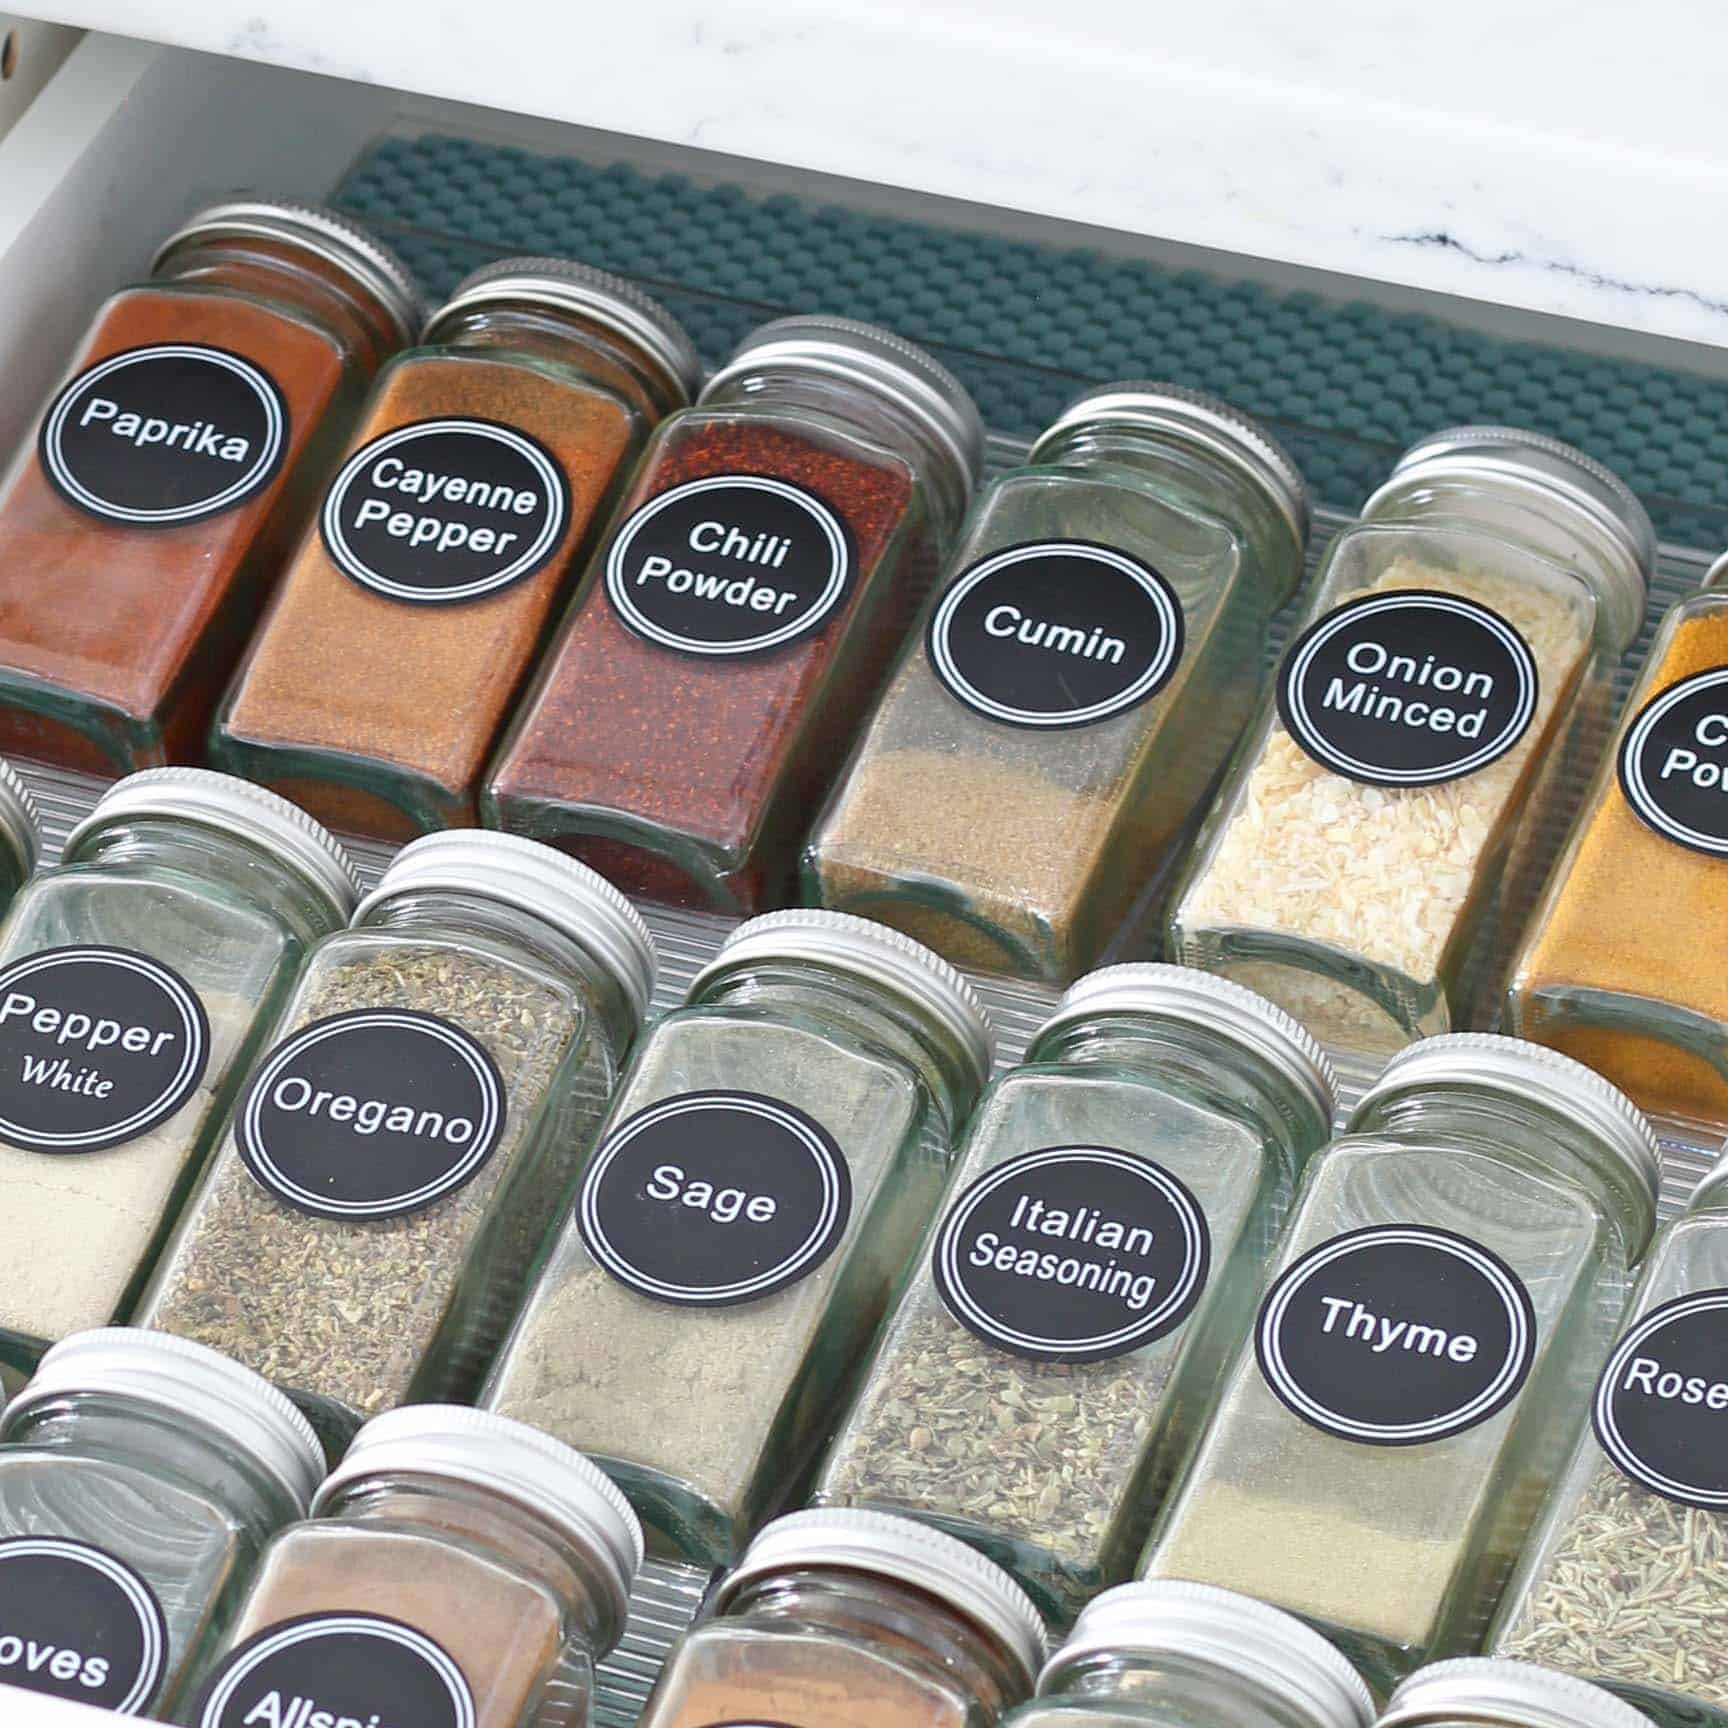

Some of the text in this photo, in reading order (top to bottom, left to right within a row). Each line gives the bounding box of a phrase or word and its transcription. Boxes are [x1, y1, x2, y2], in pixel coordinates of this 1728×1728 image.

[79, 398, 250, 462] Paprika
[372, 457, 538, 515] Cayenne
[354, 499, 518, 555] Pepper
[689, 521, 792, 568] Chili
[636, 556, 797, 615] Powder
[984, 605, 1126, 664] Cumin
[1347, 642, 1493, 699] Onion
[1322, 677, 1488, 739] Minced
[22, 1055, 114, 1099] White
[273, 1077, 473, 1145] Oregano
[646, 1165, 776, 1223] Sage
[1010, 1195, 1153, 1256] Italian
[969, 1232, 1156, 1310] Seasoning
[1321, 1296, 1477, 1362] Thyme
